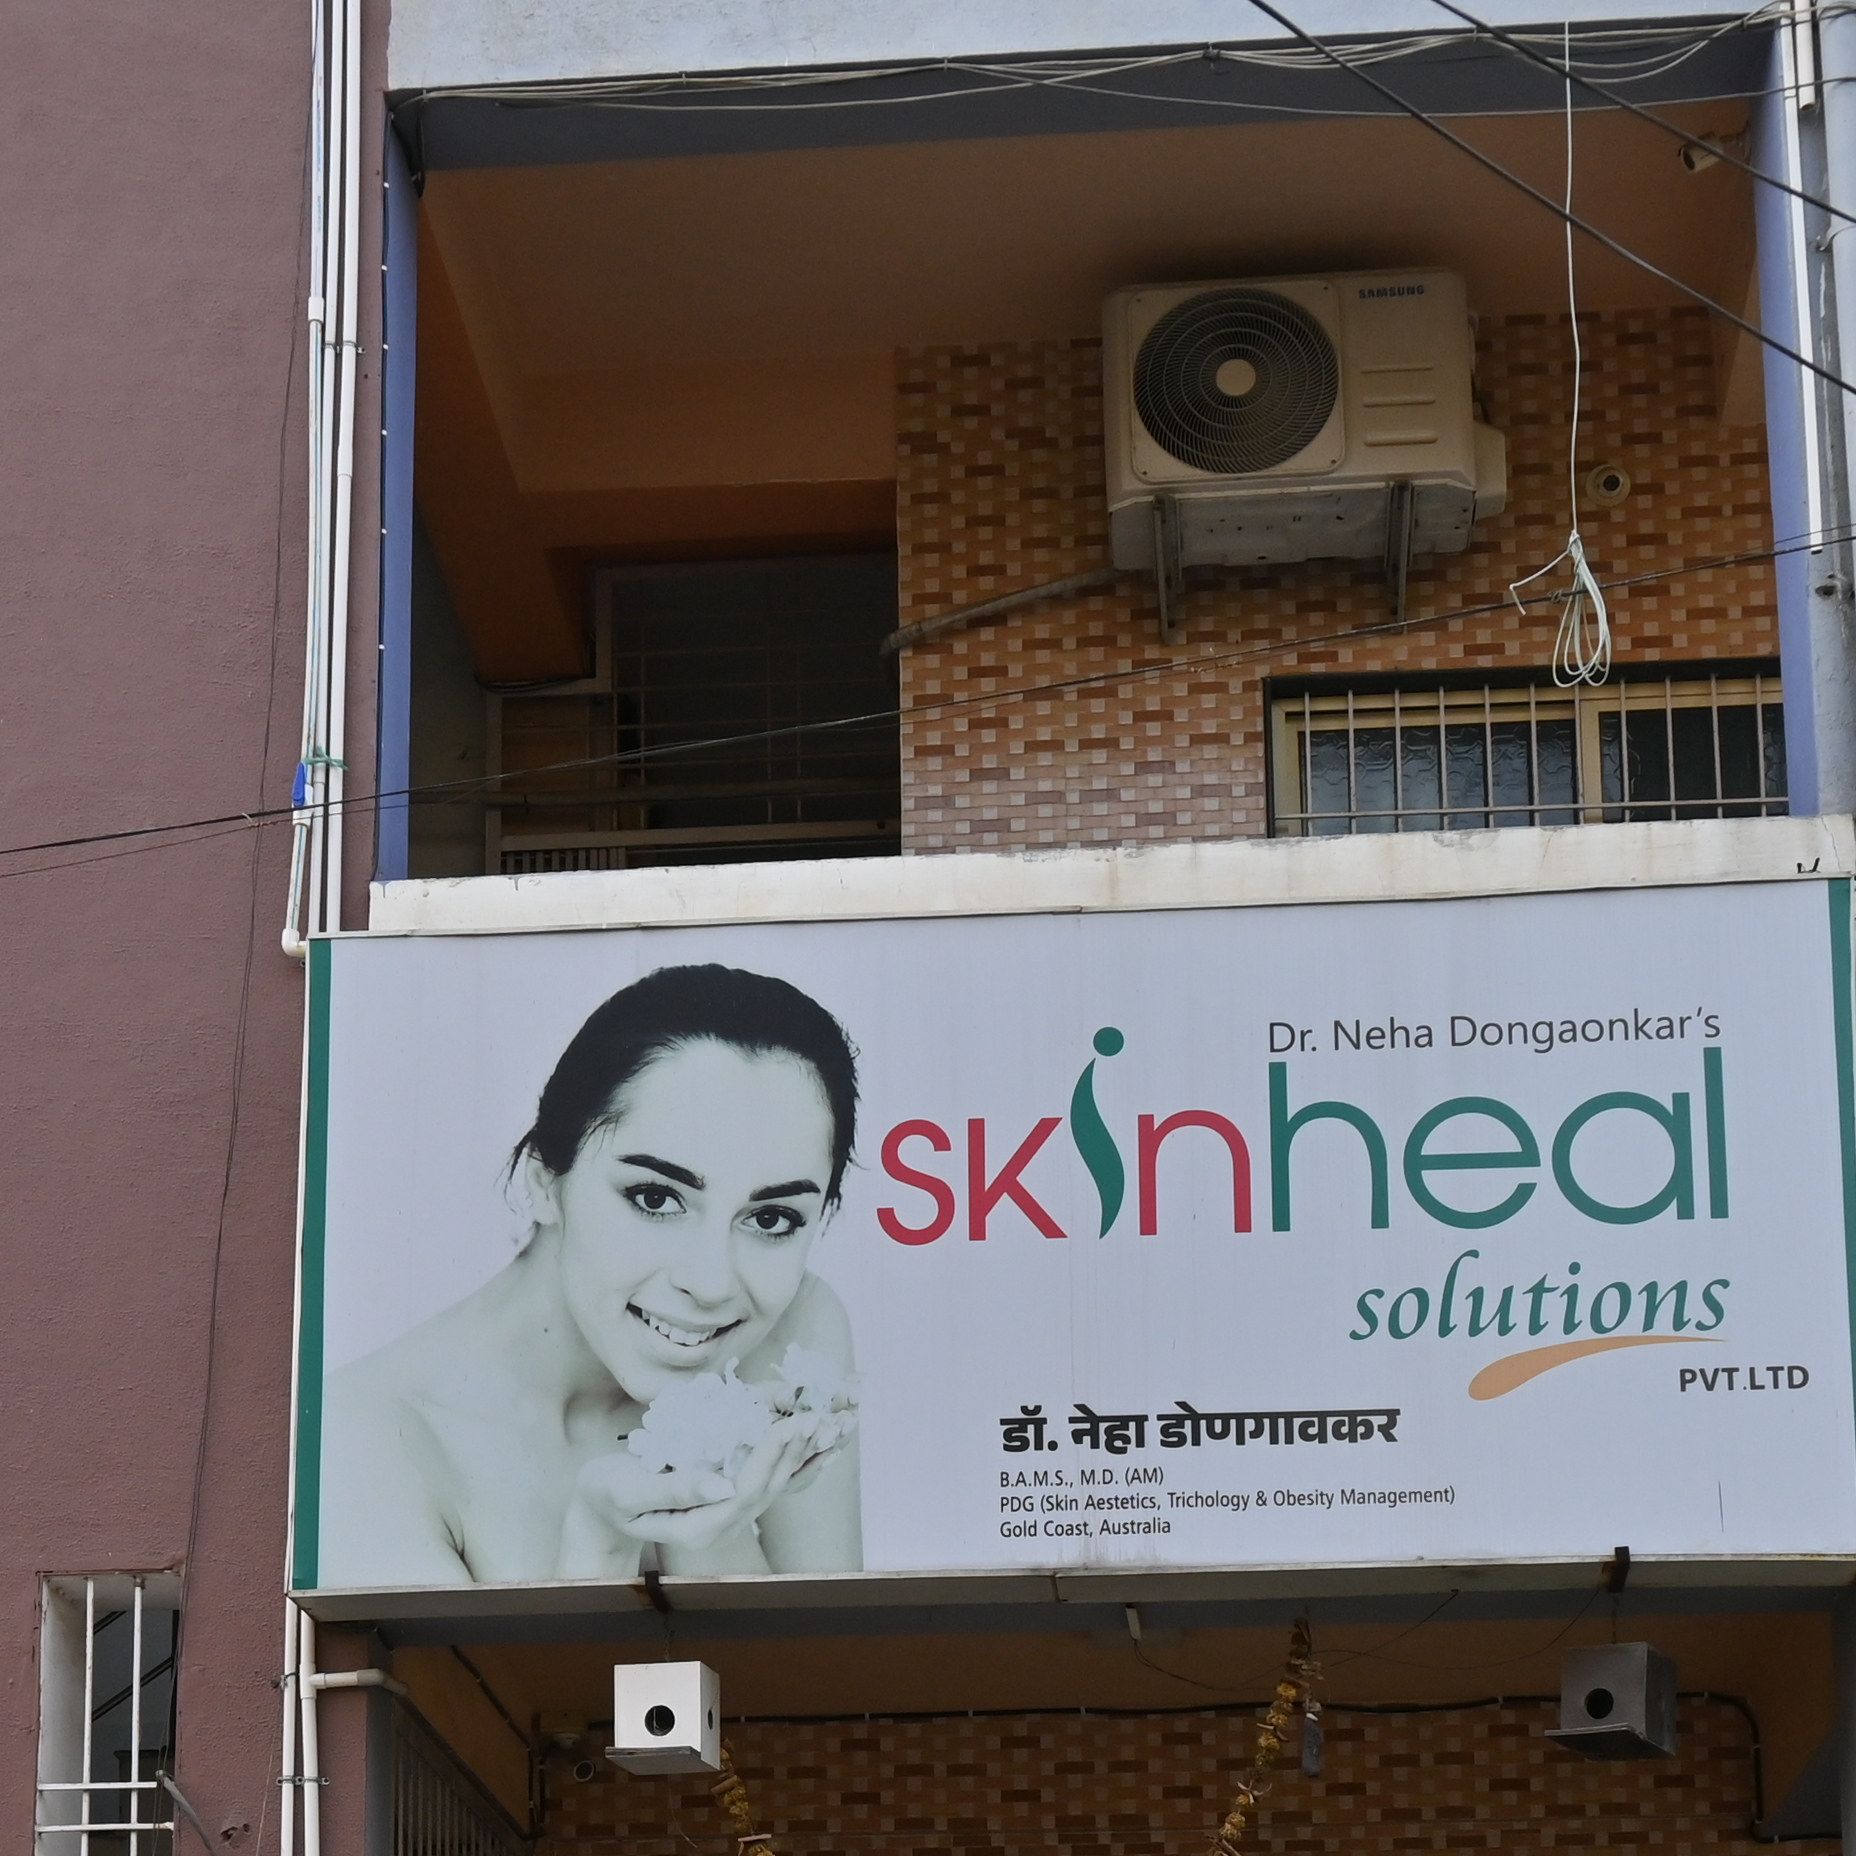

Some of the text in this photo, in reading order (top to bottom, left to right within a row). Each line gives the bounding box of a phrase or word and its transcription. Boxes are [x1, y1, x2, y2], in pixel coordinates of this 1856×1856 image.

[1358, 284, 1425, 299] SAMSUNG
[1268, 1006, 1721, 1056] Dr. Neha Dongaonkar's
[1349, 1248, 1731, 1340] solutions
[1000, 1401, 1400, 1455] डॉ. नेहा डोणगावकर
[1124, 1467, 1164, 1486] (AM)
[1000, 1485, 1456, 1513] PDG Aestetics, Trichology Obesity Management)
[999, 1518, 1171, 1538] Gold Australia
